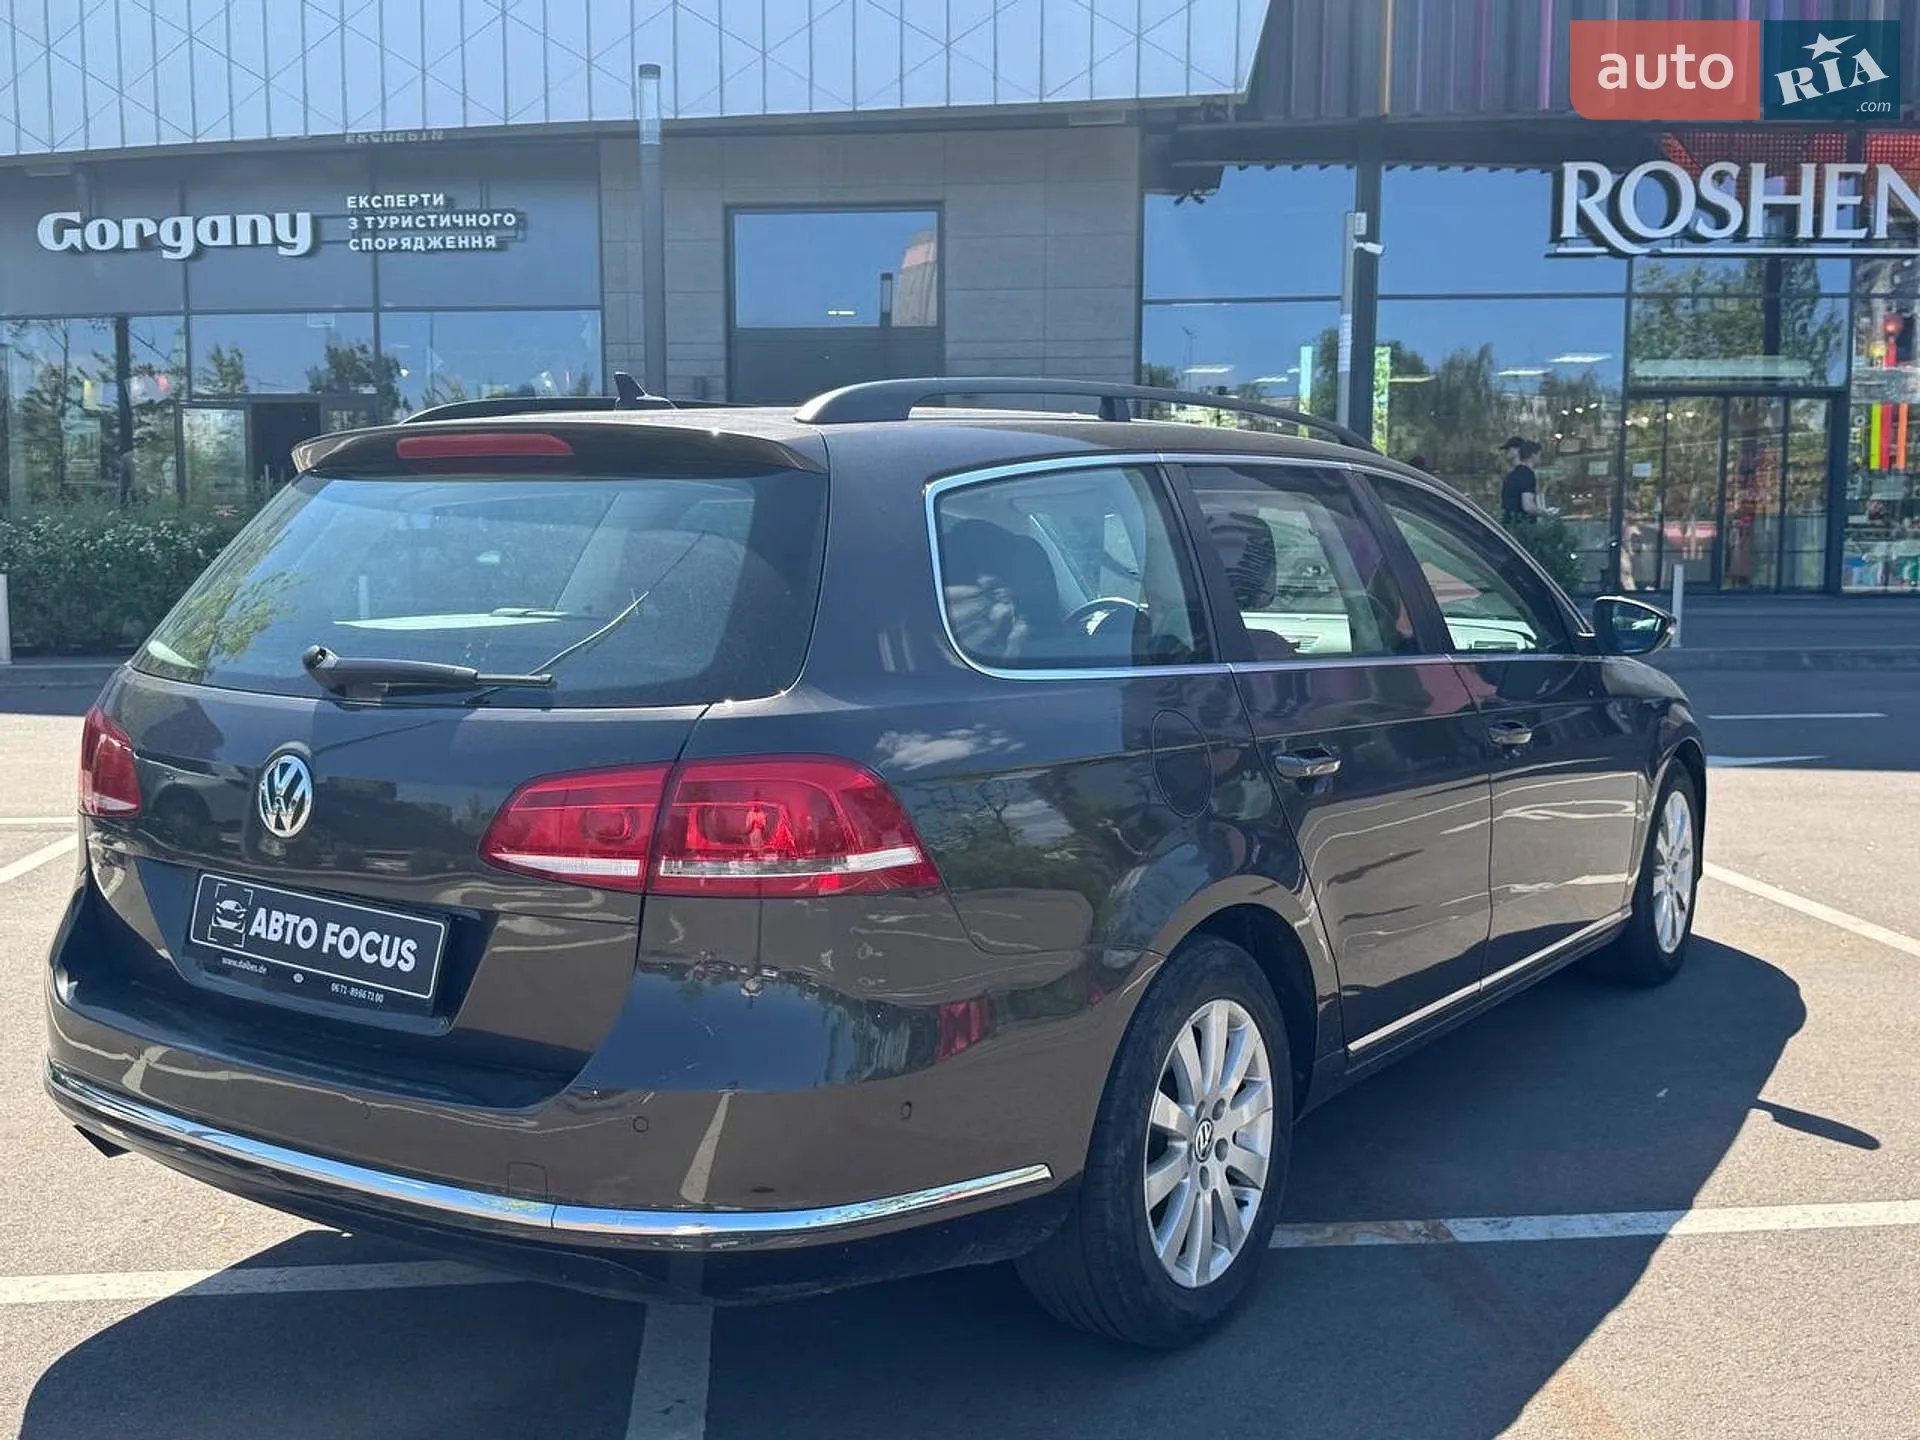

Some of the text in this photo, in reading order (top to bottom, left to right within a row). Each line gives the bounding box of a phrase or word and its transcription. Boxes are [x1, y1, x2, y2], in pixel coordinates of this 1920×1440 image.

[346, 192, 445, 209] ЕКСПЕРТИ
[1559, 160, 1920, 255] ROSHEN
[37, 210, 313, 261] Gorgany
[364, 213, 517, 230] ТУРИСТИЧНОГО
[348, 235, 497, 252] СПОРЯДЖЕННЯ
[249, 906, 418, 973] АВТО FOCUS
